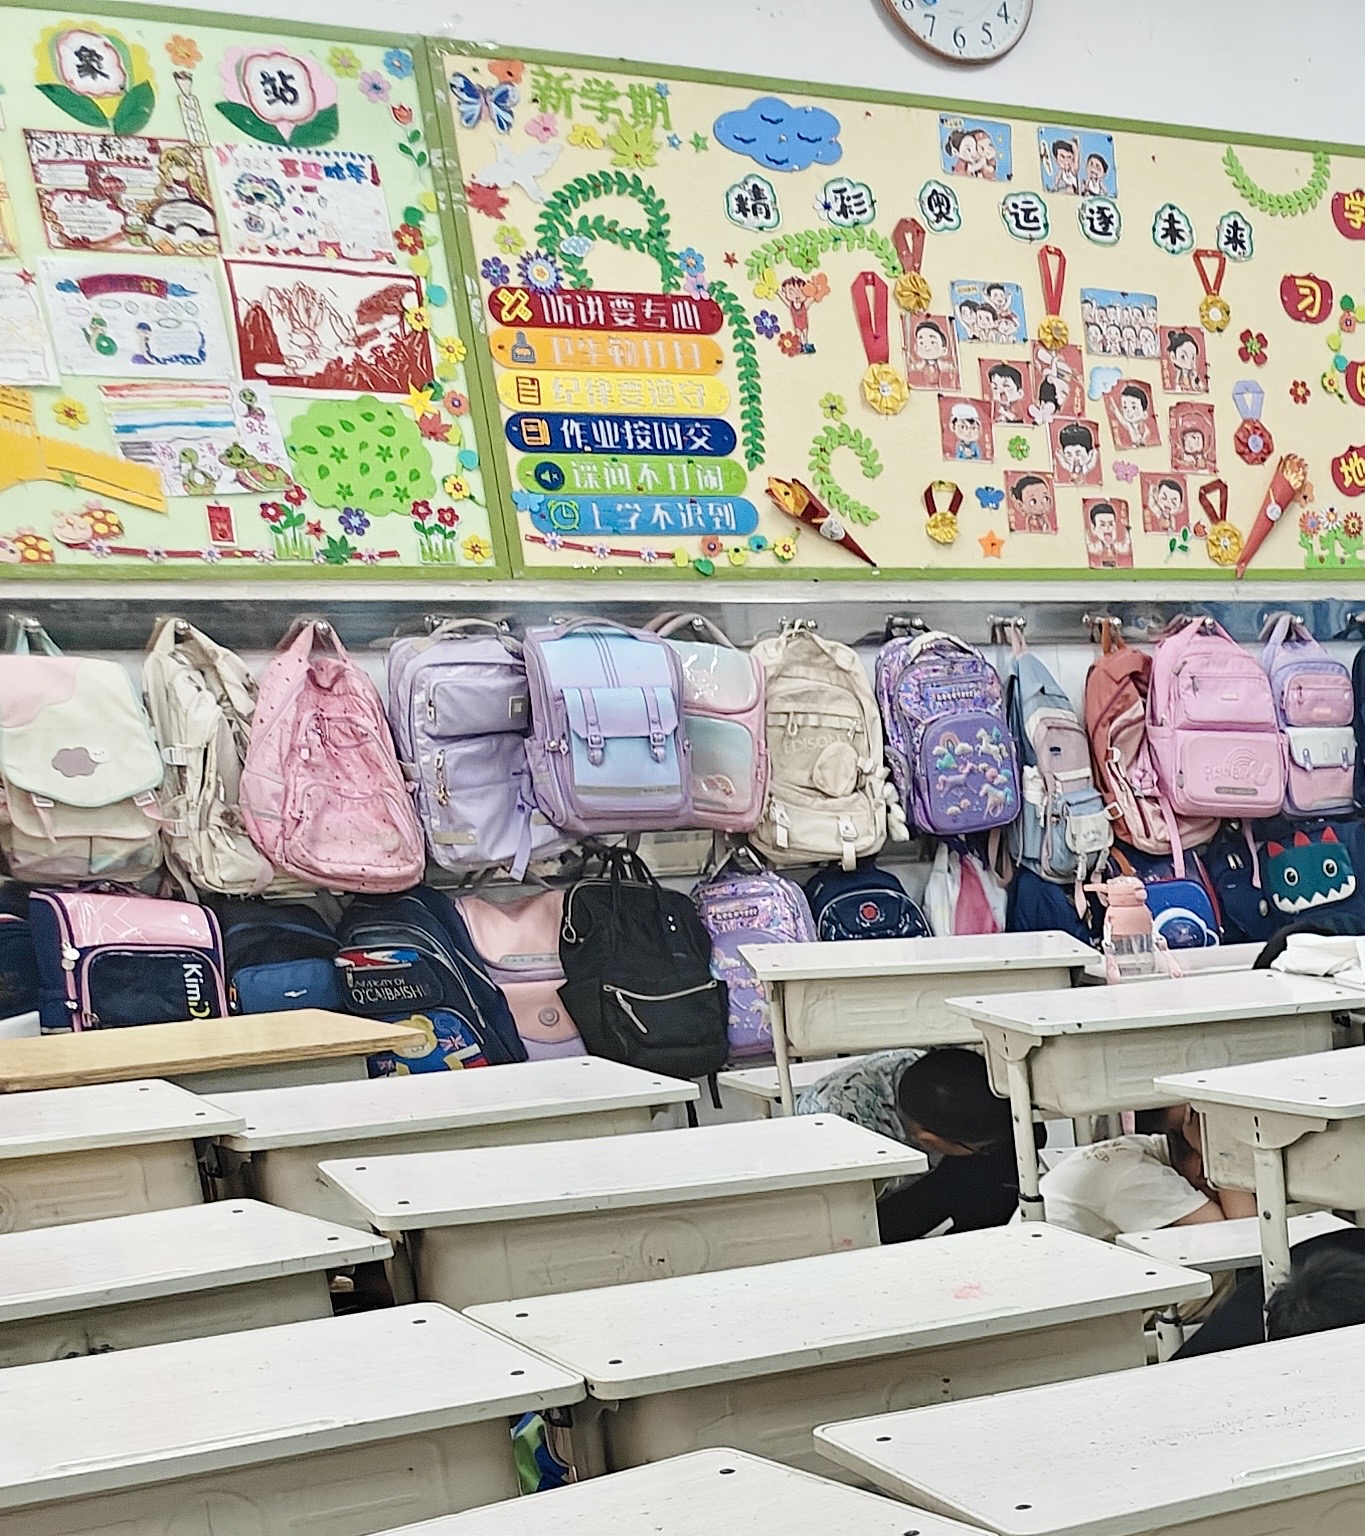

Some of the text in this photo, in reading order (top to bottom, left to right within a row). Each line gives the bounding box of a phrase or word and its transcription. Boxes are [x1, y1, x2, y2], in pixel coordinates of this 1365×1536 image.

[923, 13, 936, 38] 7
[997, 1, 1010, 24] 4
[953, 26, 966, 49] 6
[981, 22, 993, 46] 5
[531, 65, 672, 130] 新学期
[540, 295, 700, 330] 听讲要专心
[571, 460, 724, 491] 课间不打闹
[592, 502, 737, 531] 上学不迟到
